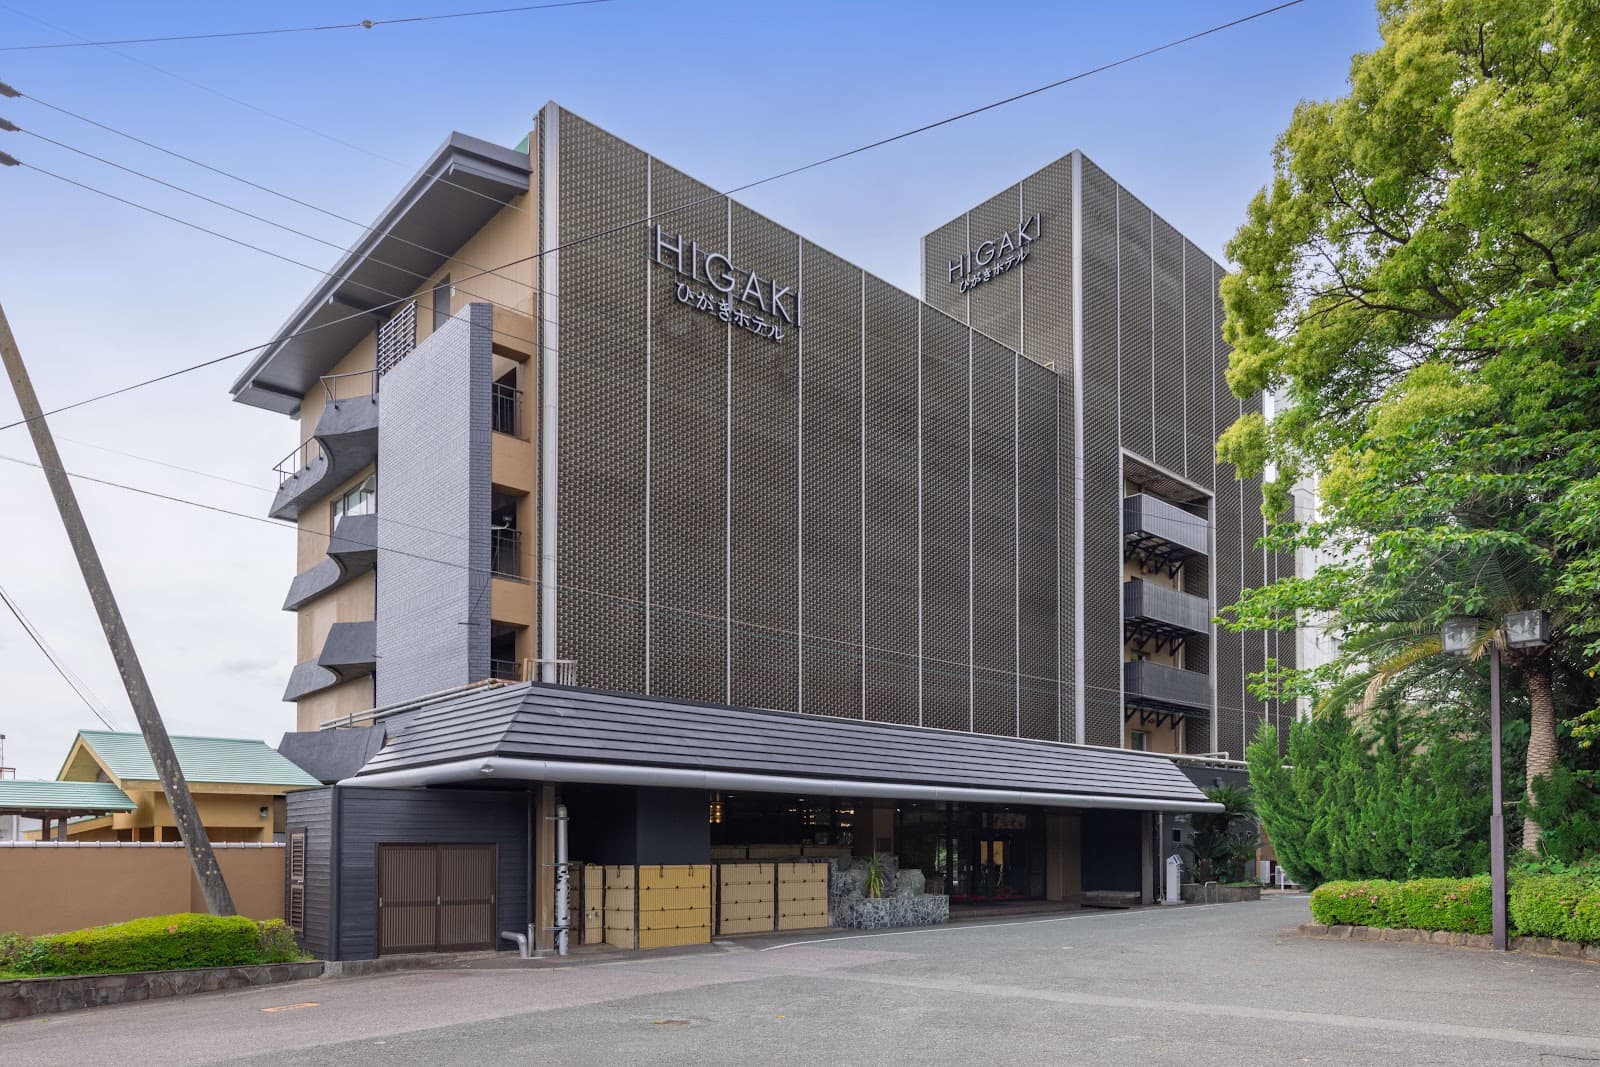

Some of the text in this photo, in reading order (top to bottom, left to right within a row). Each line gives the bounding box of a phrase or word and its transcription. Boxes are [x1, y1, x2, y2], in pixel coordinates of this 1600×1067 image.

[656, 224, 801, 327] HIGAKI
[948, 212, 1041, 283] HIGAKI
[960, 250, 1029, 293] ひがきホテル
[676, 282, 785, 341] ひがきホテル
